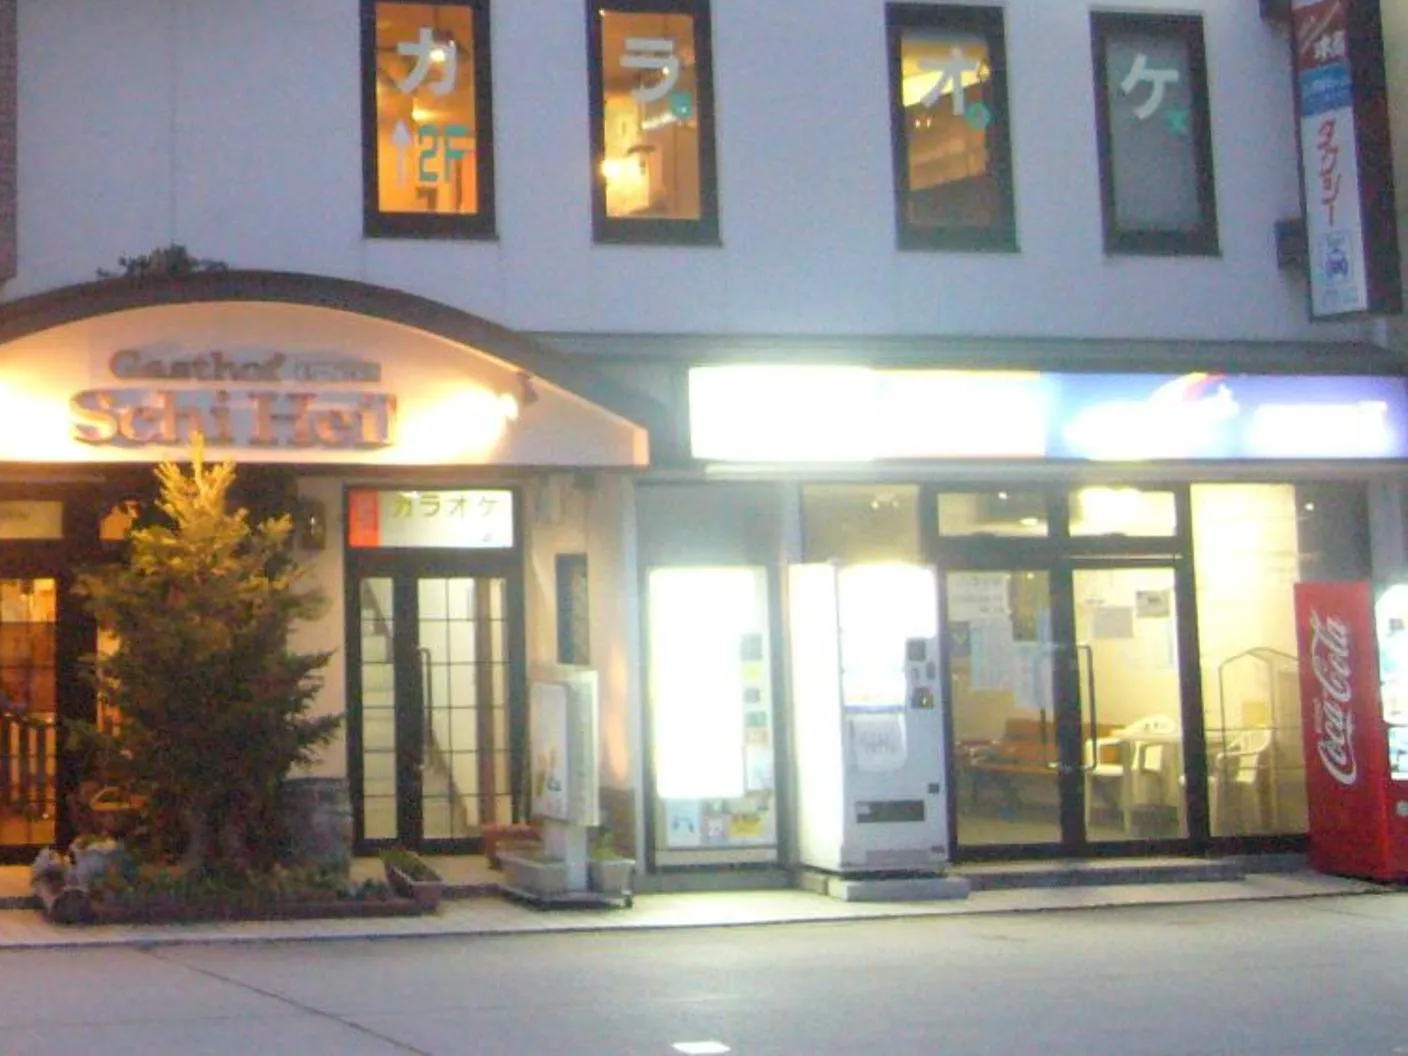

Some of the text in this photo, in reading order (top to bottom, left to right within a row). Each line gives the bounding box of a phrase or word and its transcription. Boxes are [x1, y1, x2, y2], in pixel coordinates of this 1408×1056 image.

[417, 123, 474, 183] 2F
[109, 348, 289, 382] Gasthof
[69, 389, 398, 451] Schi Heil
[393, 493, 500, 522] カラオケ
